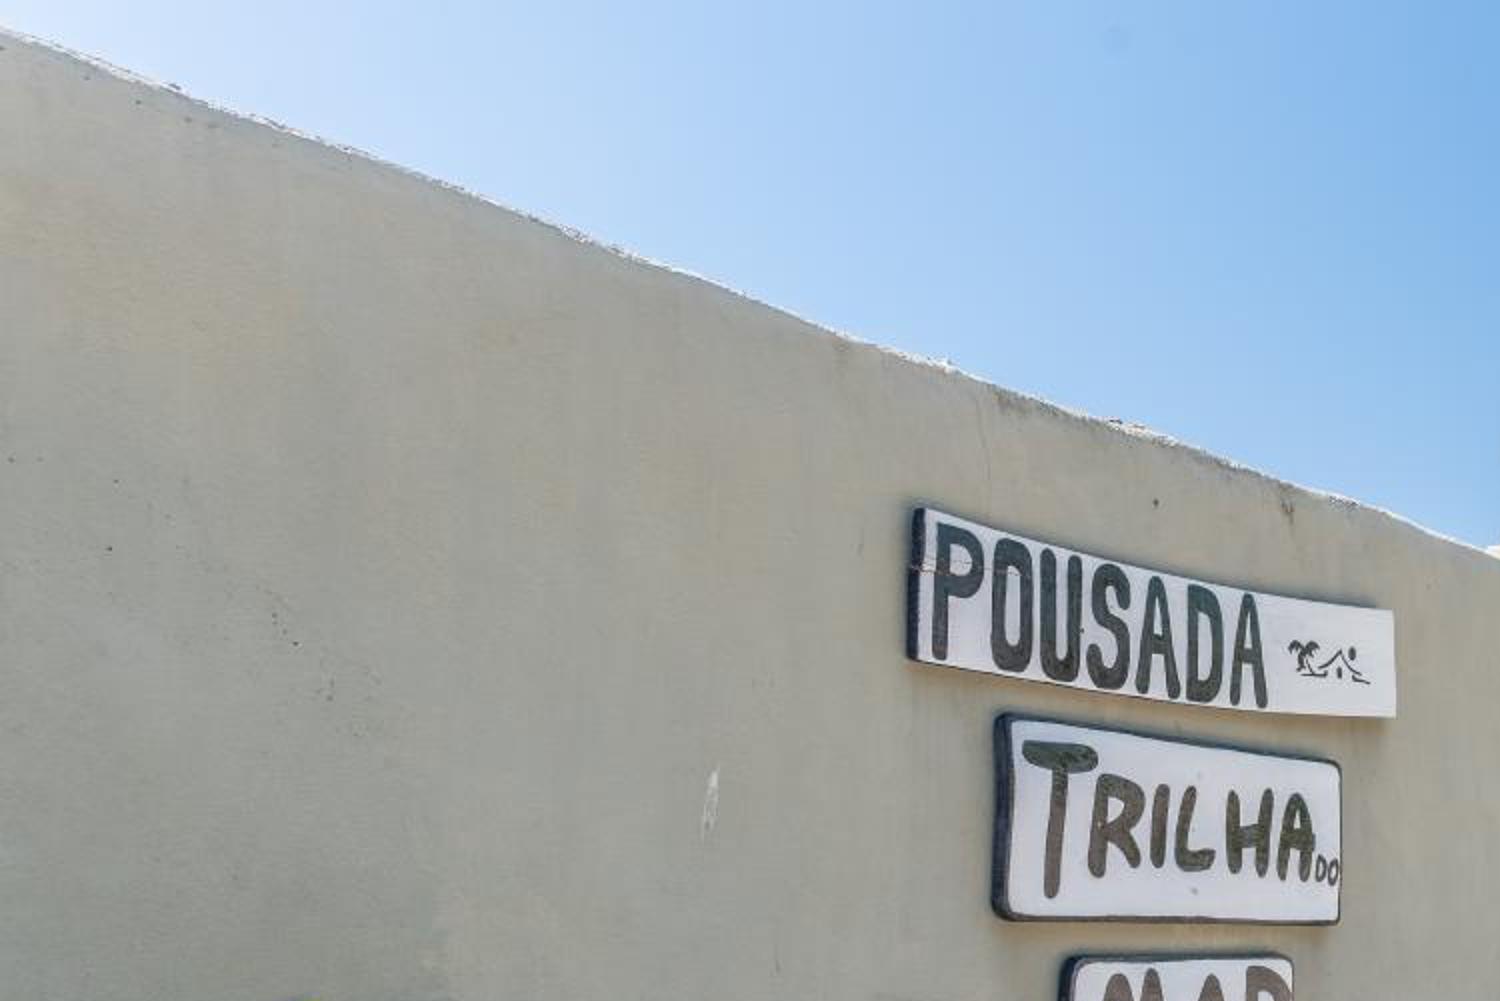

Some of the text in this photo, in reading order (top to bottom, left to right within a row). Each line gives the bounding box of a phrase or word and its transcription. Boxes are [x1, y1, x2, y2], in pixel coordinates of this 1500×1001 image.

[931, 521, 1268, 709] POUSADA
[1021, 740, 1340, 899] TRILHA DO
